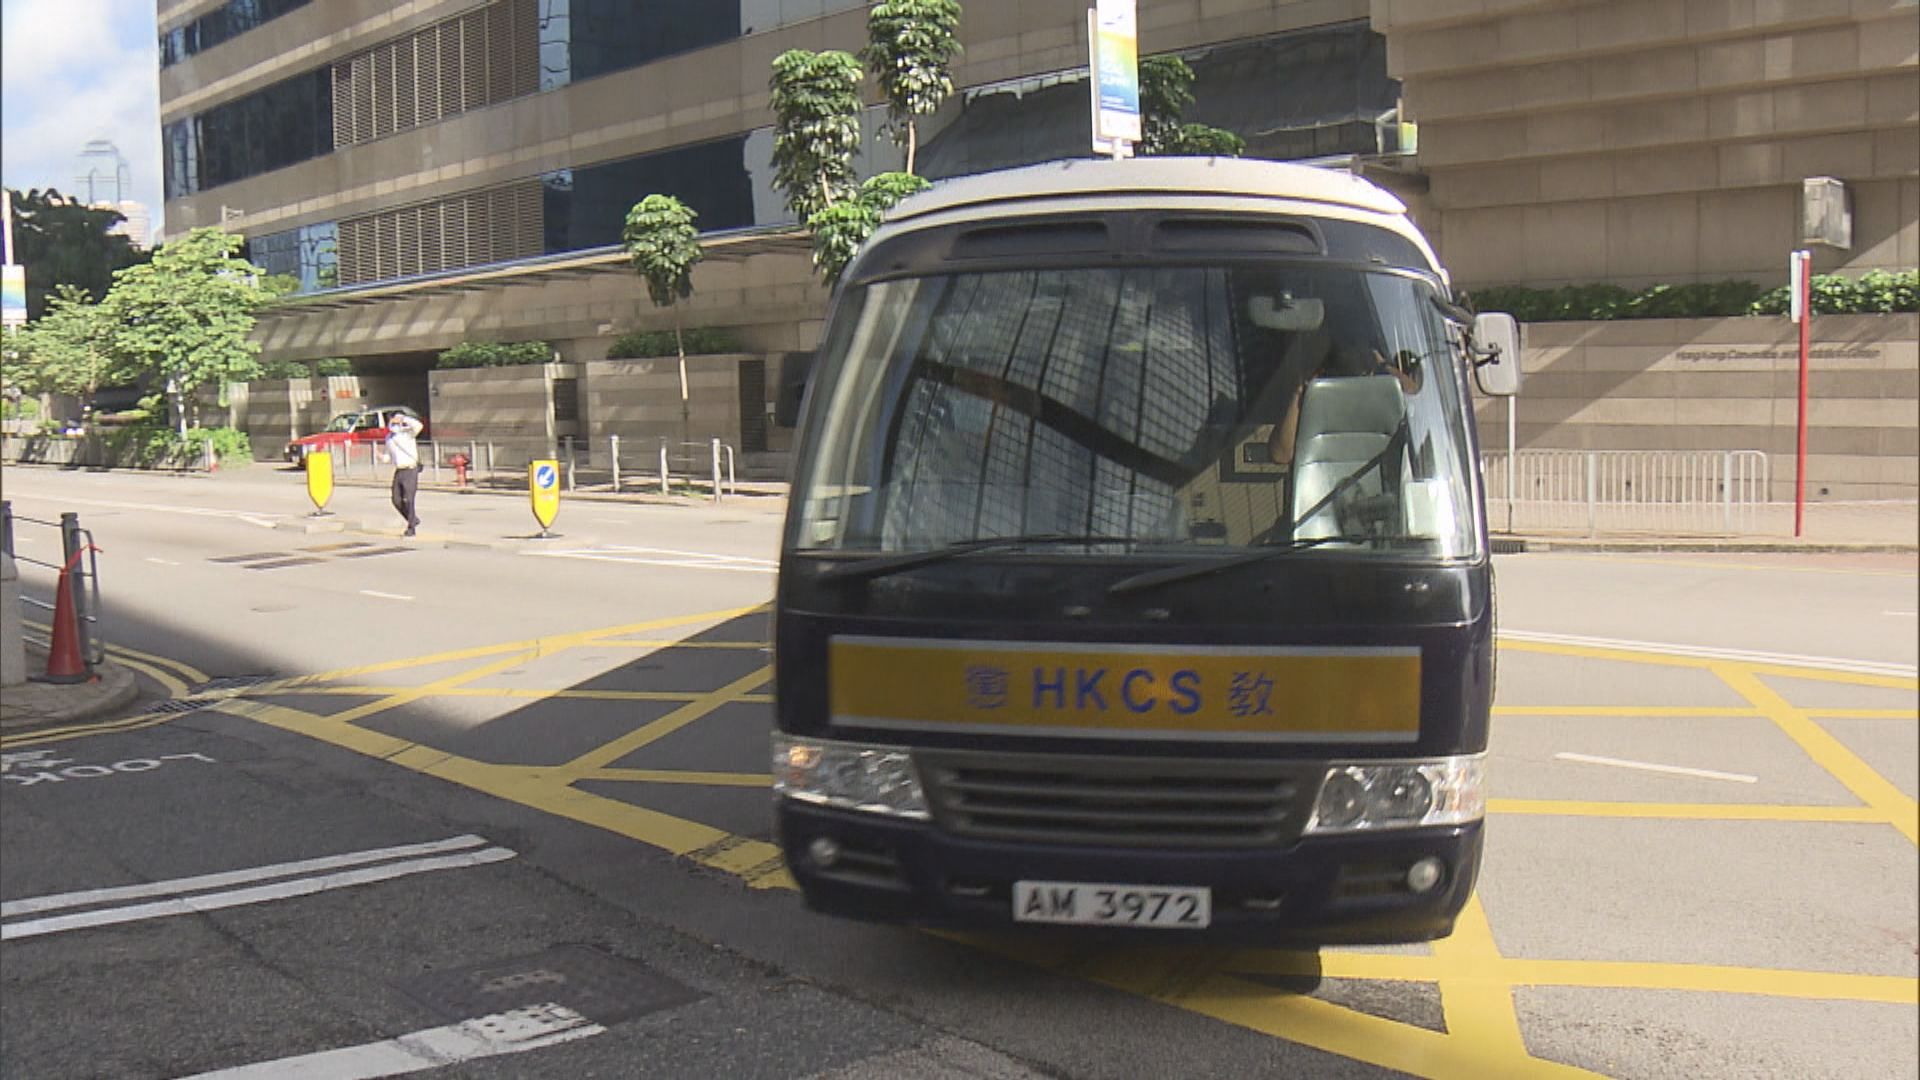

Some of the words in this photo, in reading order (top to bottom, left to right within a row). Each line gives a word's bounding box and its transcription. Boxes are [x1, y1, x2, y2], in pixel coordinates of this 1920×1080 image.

[1032, 667, 1203, 714] HKCS
[1023, 886, 1077, 918] AM
[1096, 890, 1203, 923] 3972
